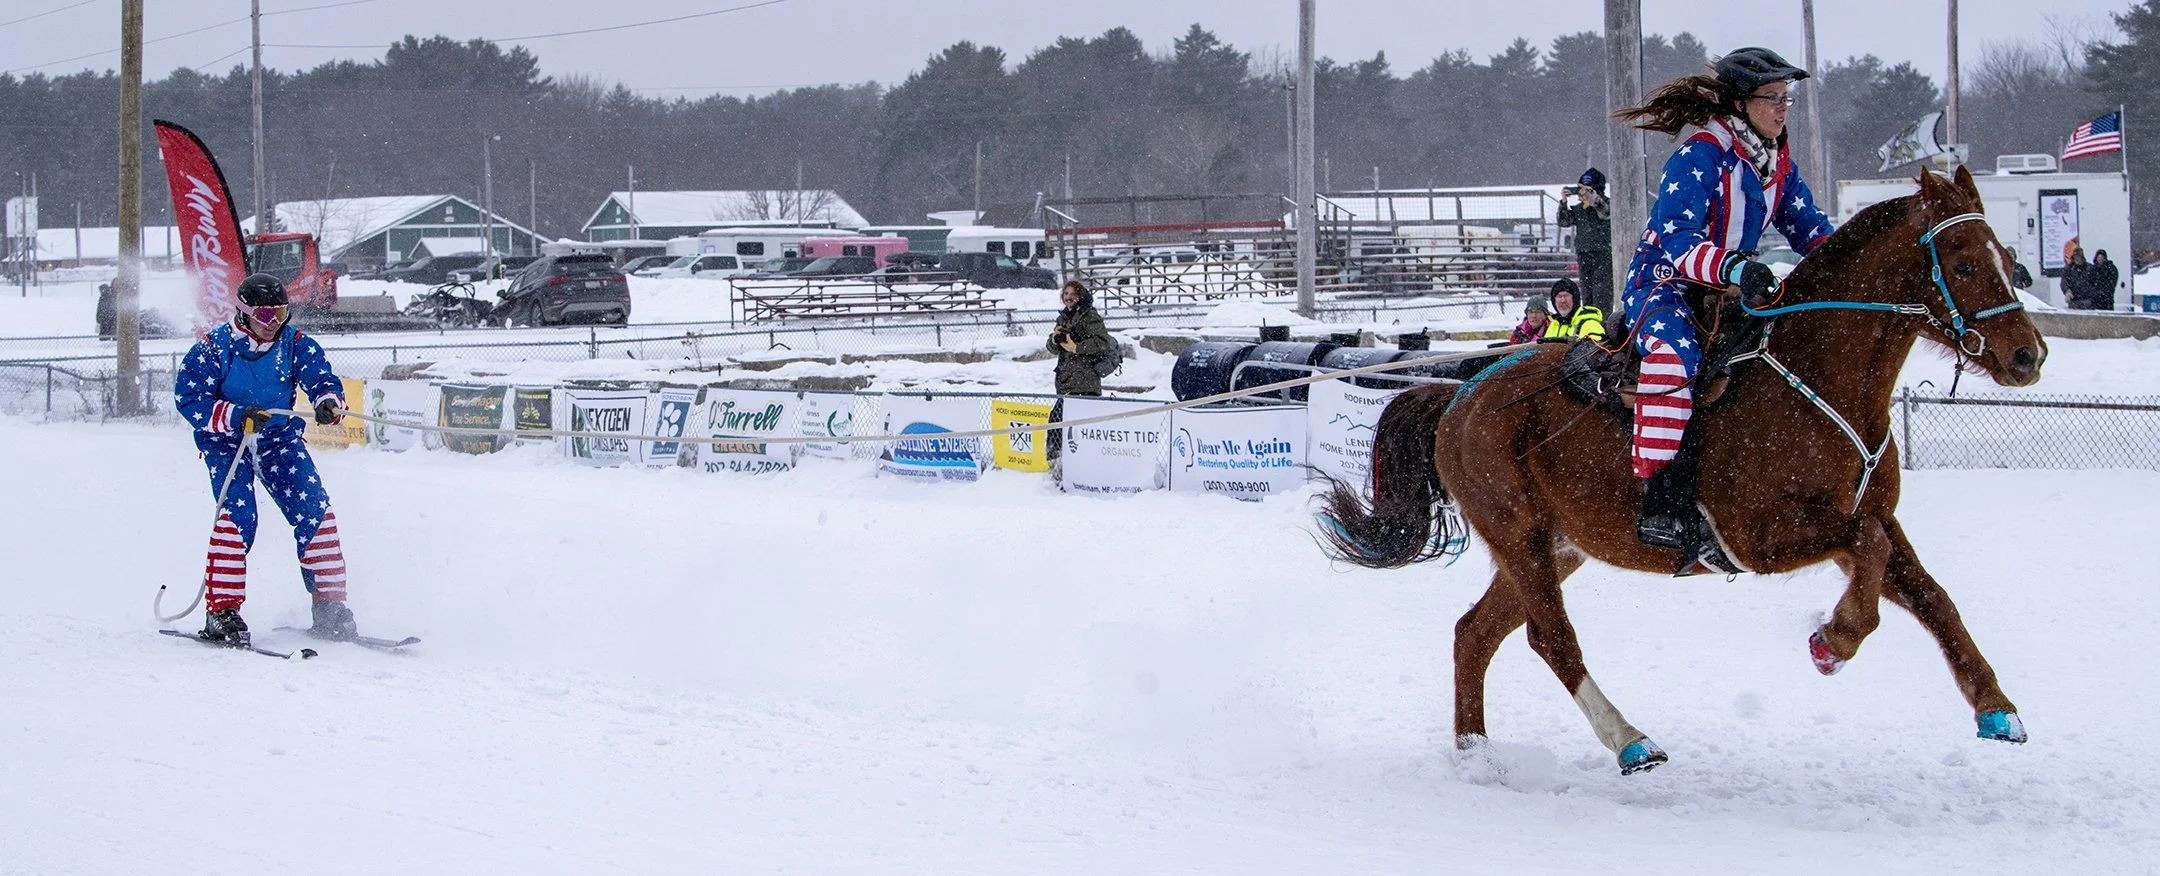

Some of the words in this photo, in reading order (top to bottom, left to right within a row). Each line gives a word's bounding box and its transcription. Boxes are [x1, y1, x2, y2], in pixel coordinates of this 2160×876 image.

[1344, 392, 1385, 406] ROOFING
[708, 400, 784, 432] O'Farrell
[1081, 428, 1130, 442] HARVEST
[1101, 446, 1142, 457] ORGANICS
[1222, 440, 1241, 455] Me
[1245, 437, 1291, 459] Again
[1319, 441, 1344, 455] HOME
[1198, 457, 1228, 469] Restoring
[1229, 460, 1258, 470] Quality
[1260, 458, 1269, 468] of
[1271, 456, 1293, 468] Life
[1228, 481, 1271, 492] 309-9001
